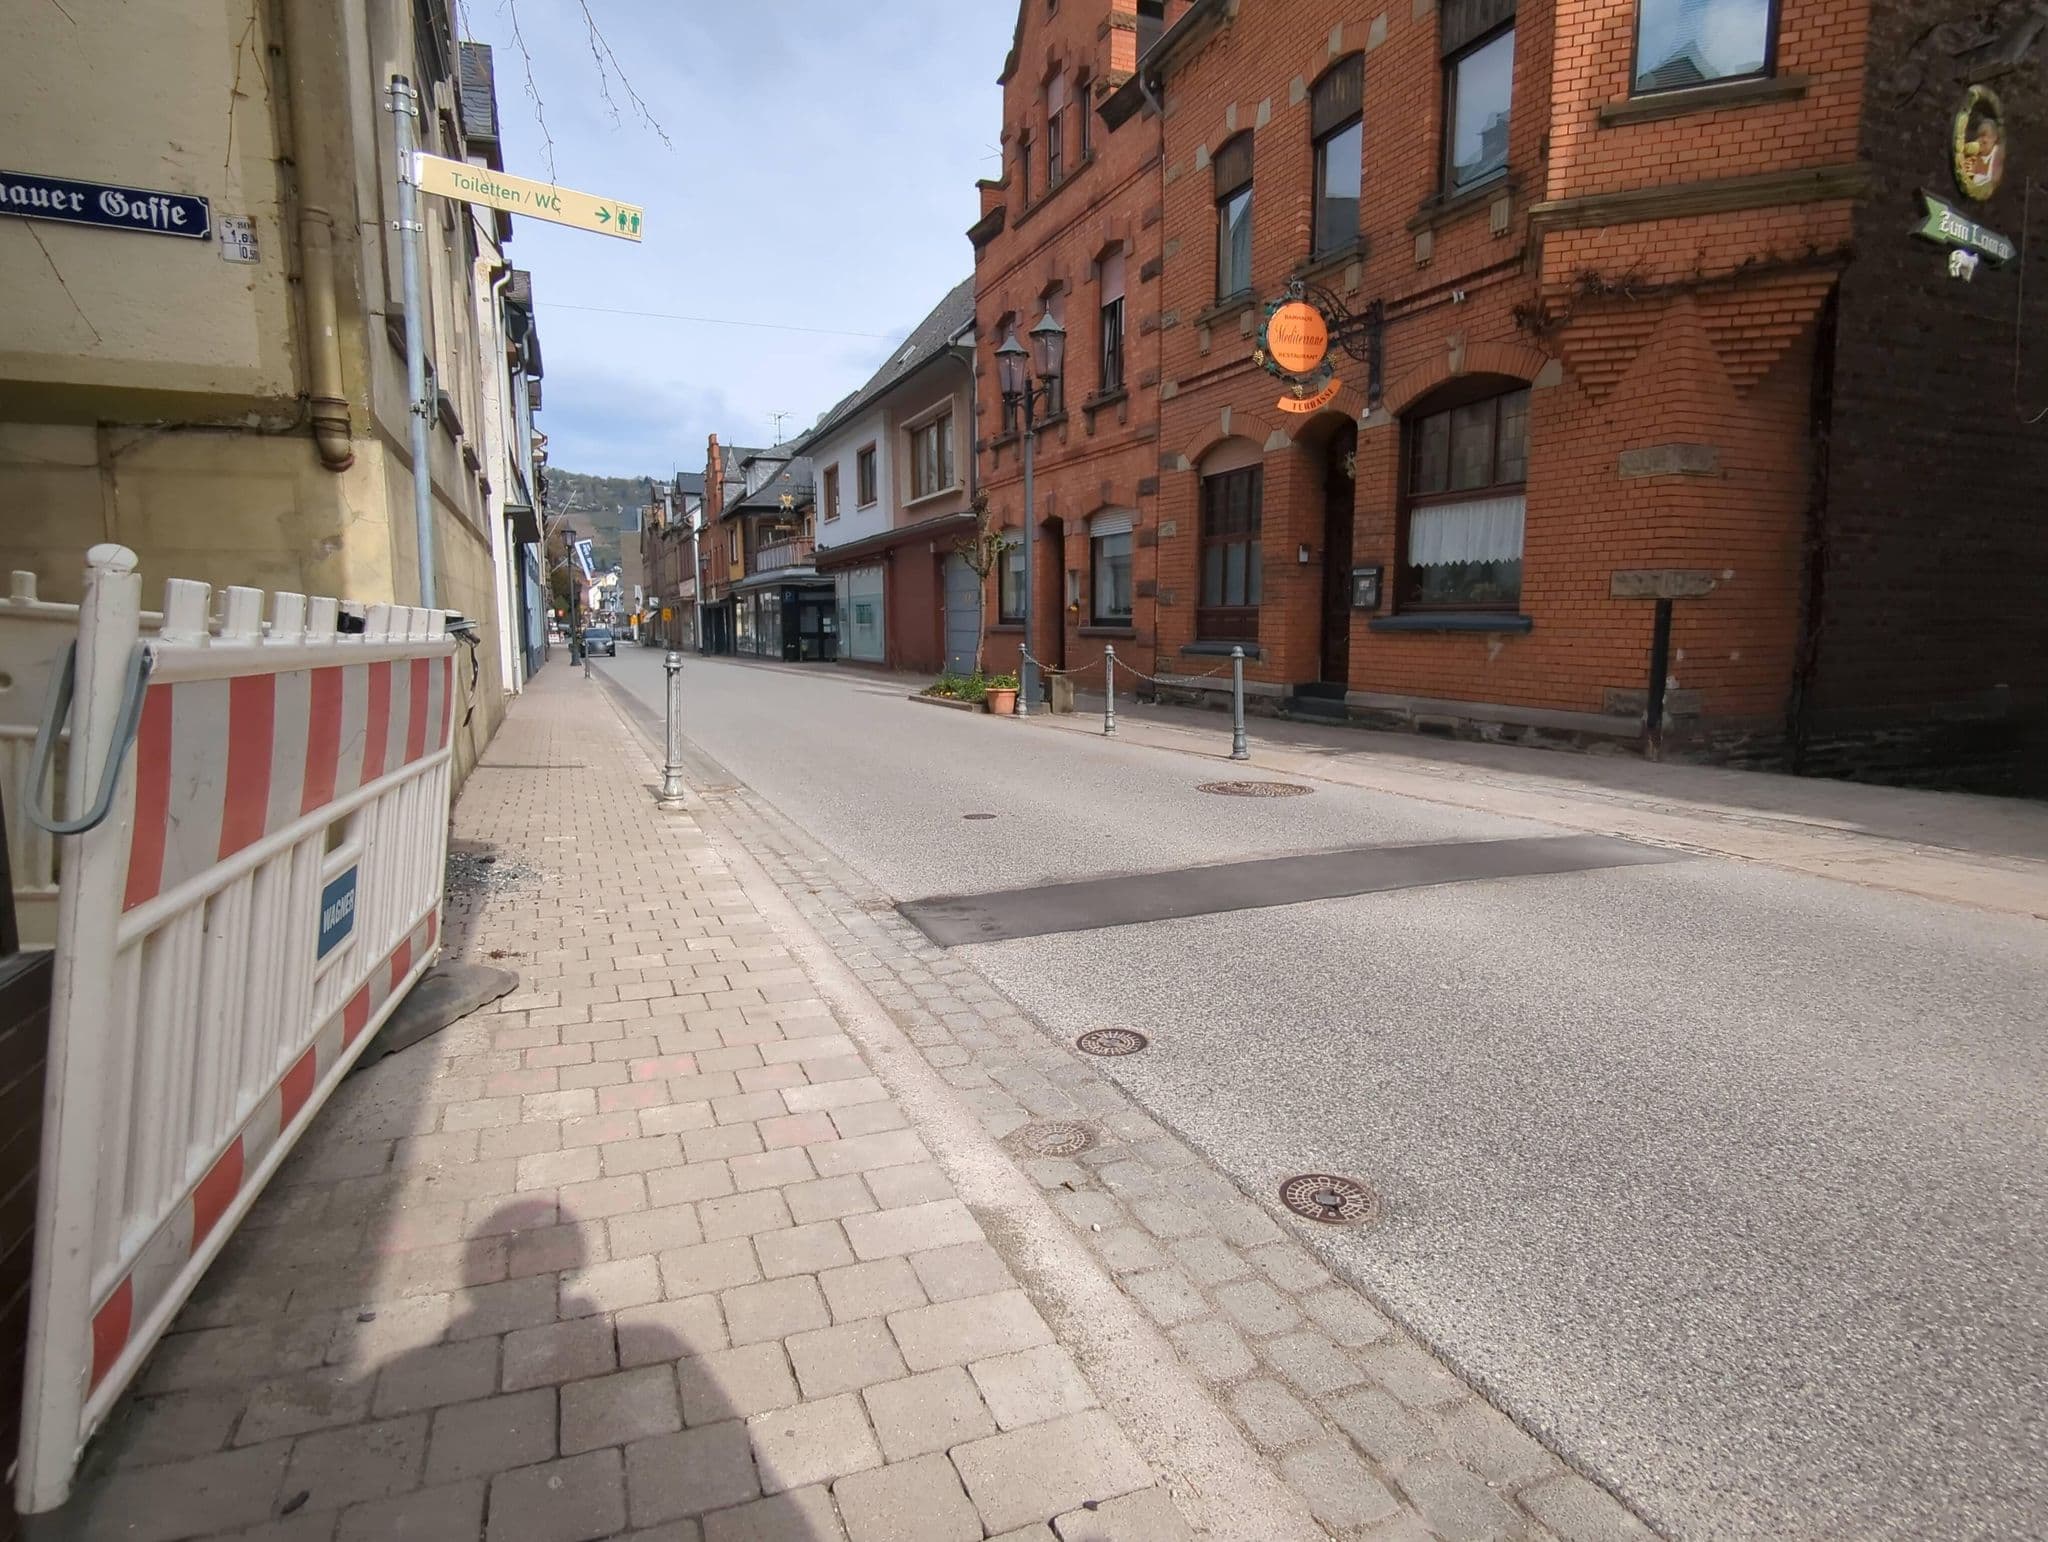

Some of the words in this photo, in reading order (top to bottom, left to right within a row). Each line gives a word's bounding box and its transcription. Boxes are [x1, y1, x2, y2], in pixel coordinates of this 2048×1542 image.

[451, 172, 520, 203] Toiletten
[535, 192, 562, 212] WC
[323, 888, 355, 934] WAGNER
